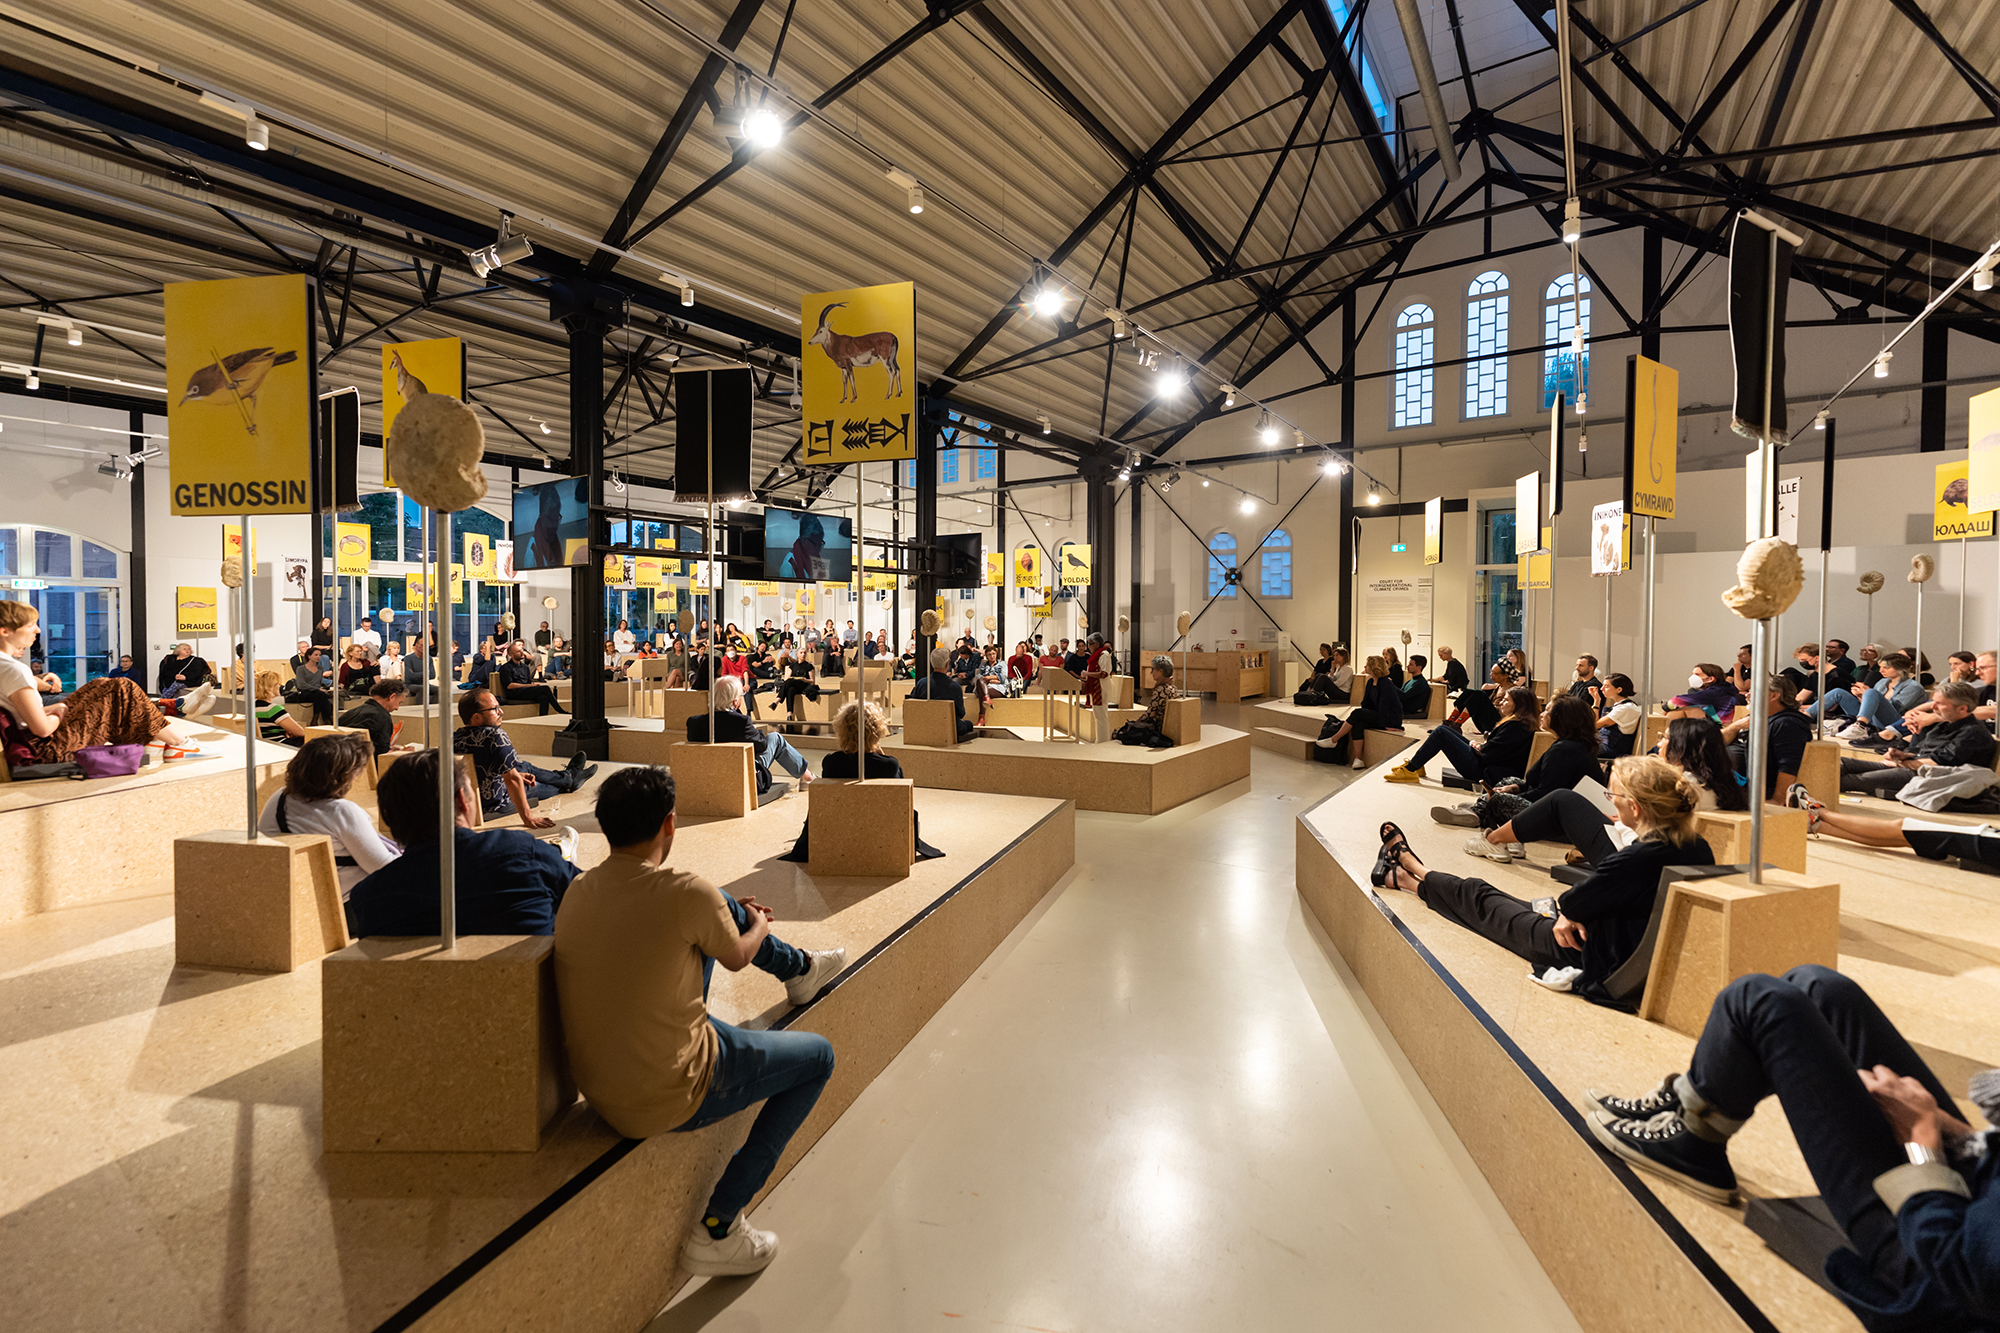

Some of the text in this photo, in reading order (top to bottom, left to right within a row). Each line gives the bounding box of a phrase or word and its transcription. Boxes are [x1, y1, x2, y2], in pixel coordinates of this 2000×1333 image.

[175, 480, 306, 508] GENOSSIN
[1634, 491, 1674, 513] CYMRAWD
[1936, 520, 1990, 536] ЮЛДАШ
